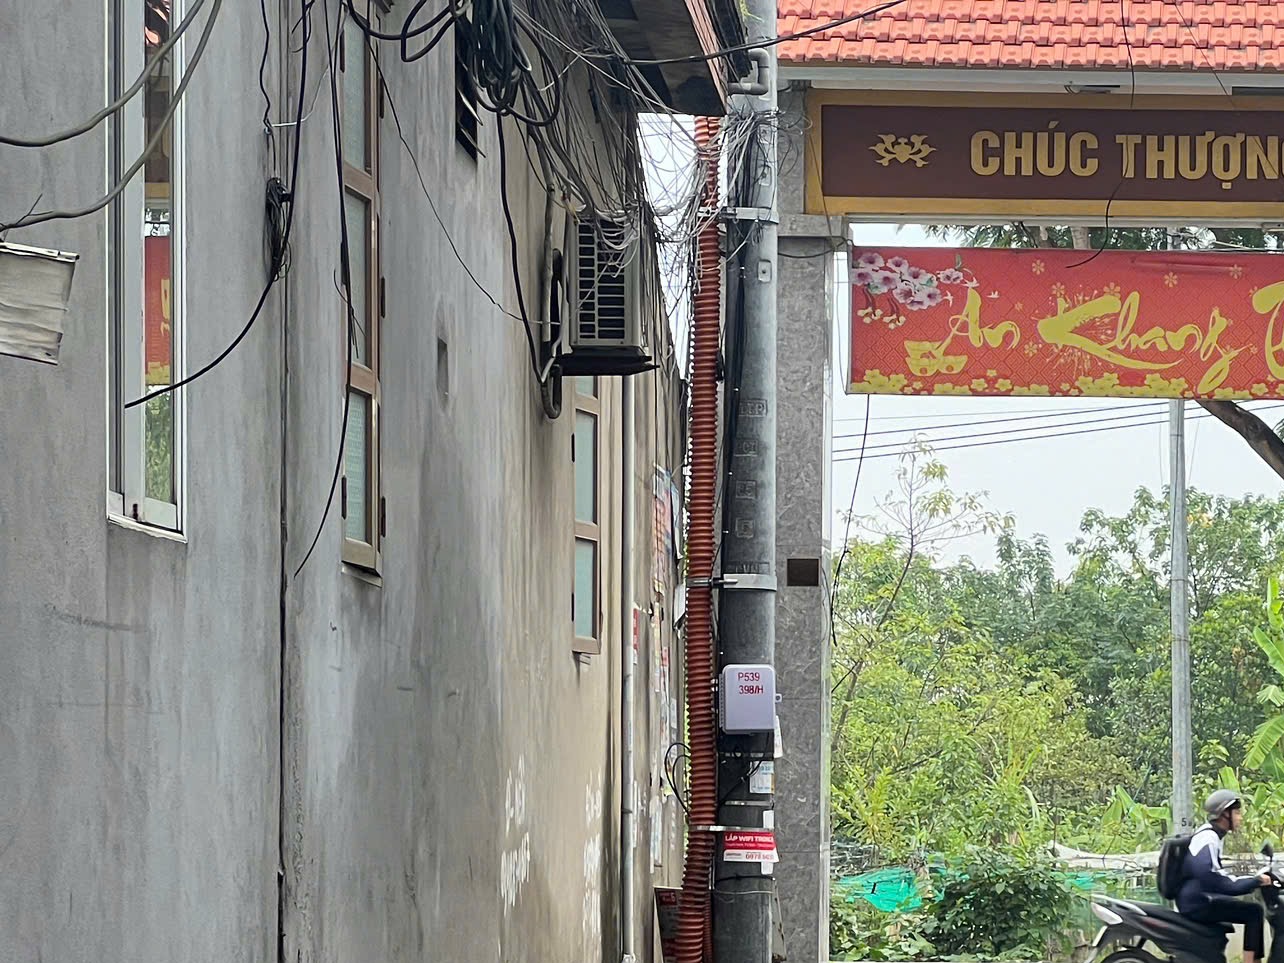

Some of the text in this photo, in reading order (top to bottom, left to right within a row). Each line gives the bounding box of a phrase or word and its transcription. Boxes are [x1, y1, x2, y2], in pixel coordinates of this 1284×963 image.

[970, 120, 1099, 177] CHÚC
[936, 287, 1021, 352] An
[1037, 291, 1251, 394] Khang
[737, 672, 760, 681] P539
